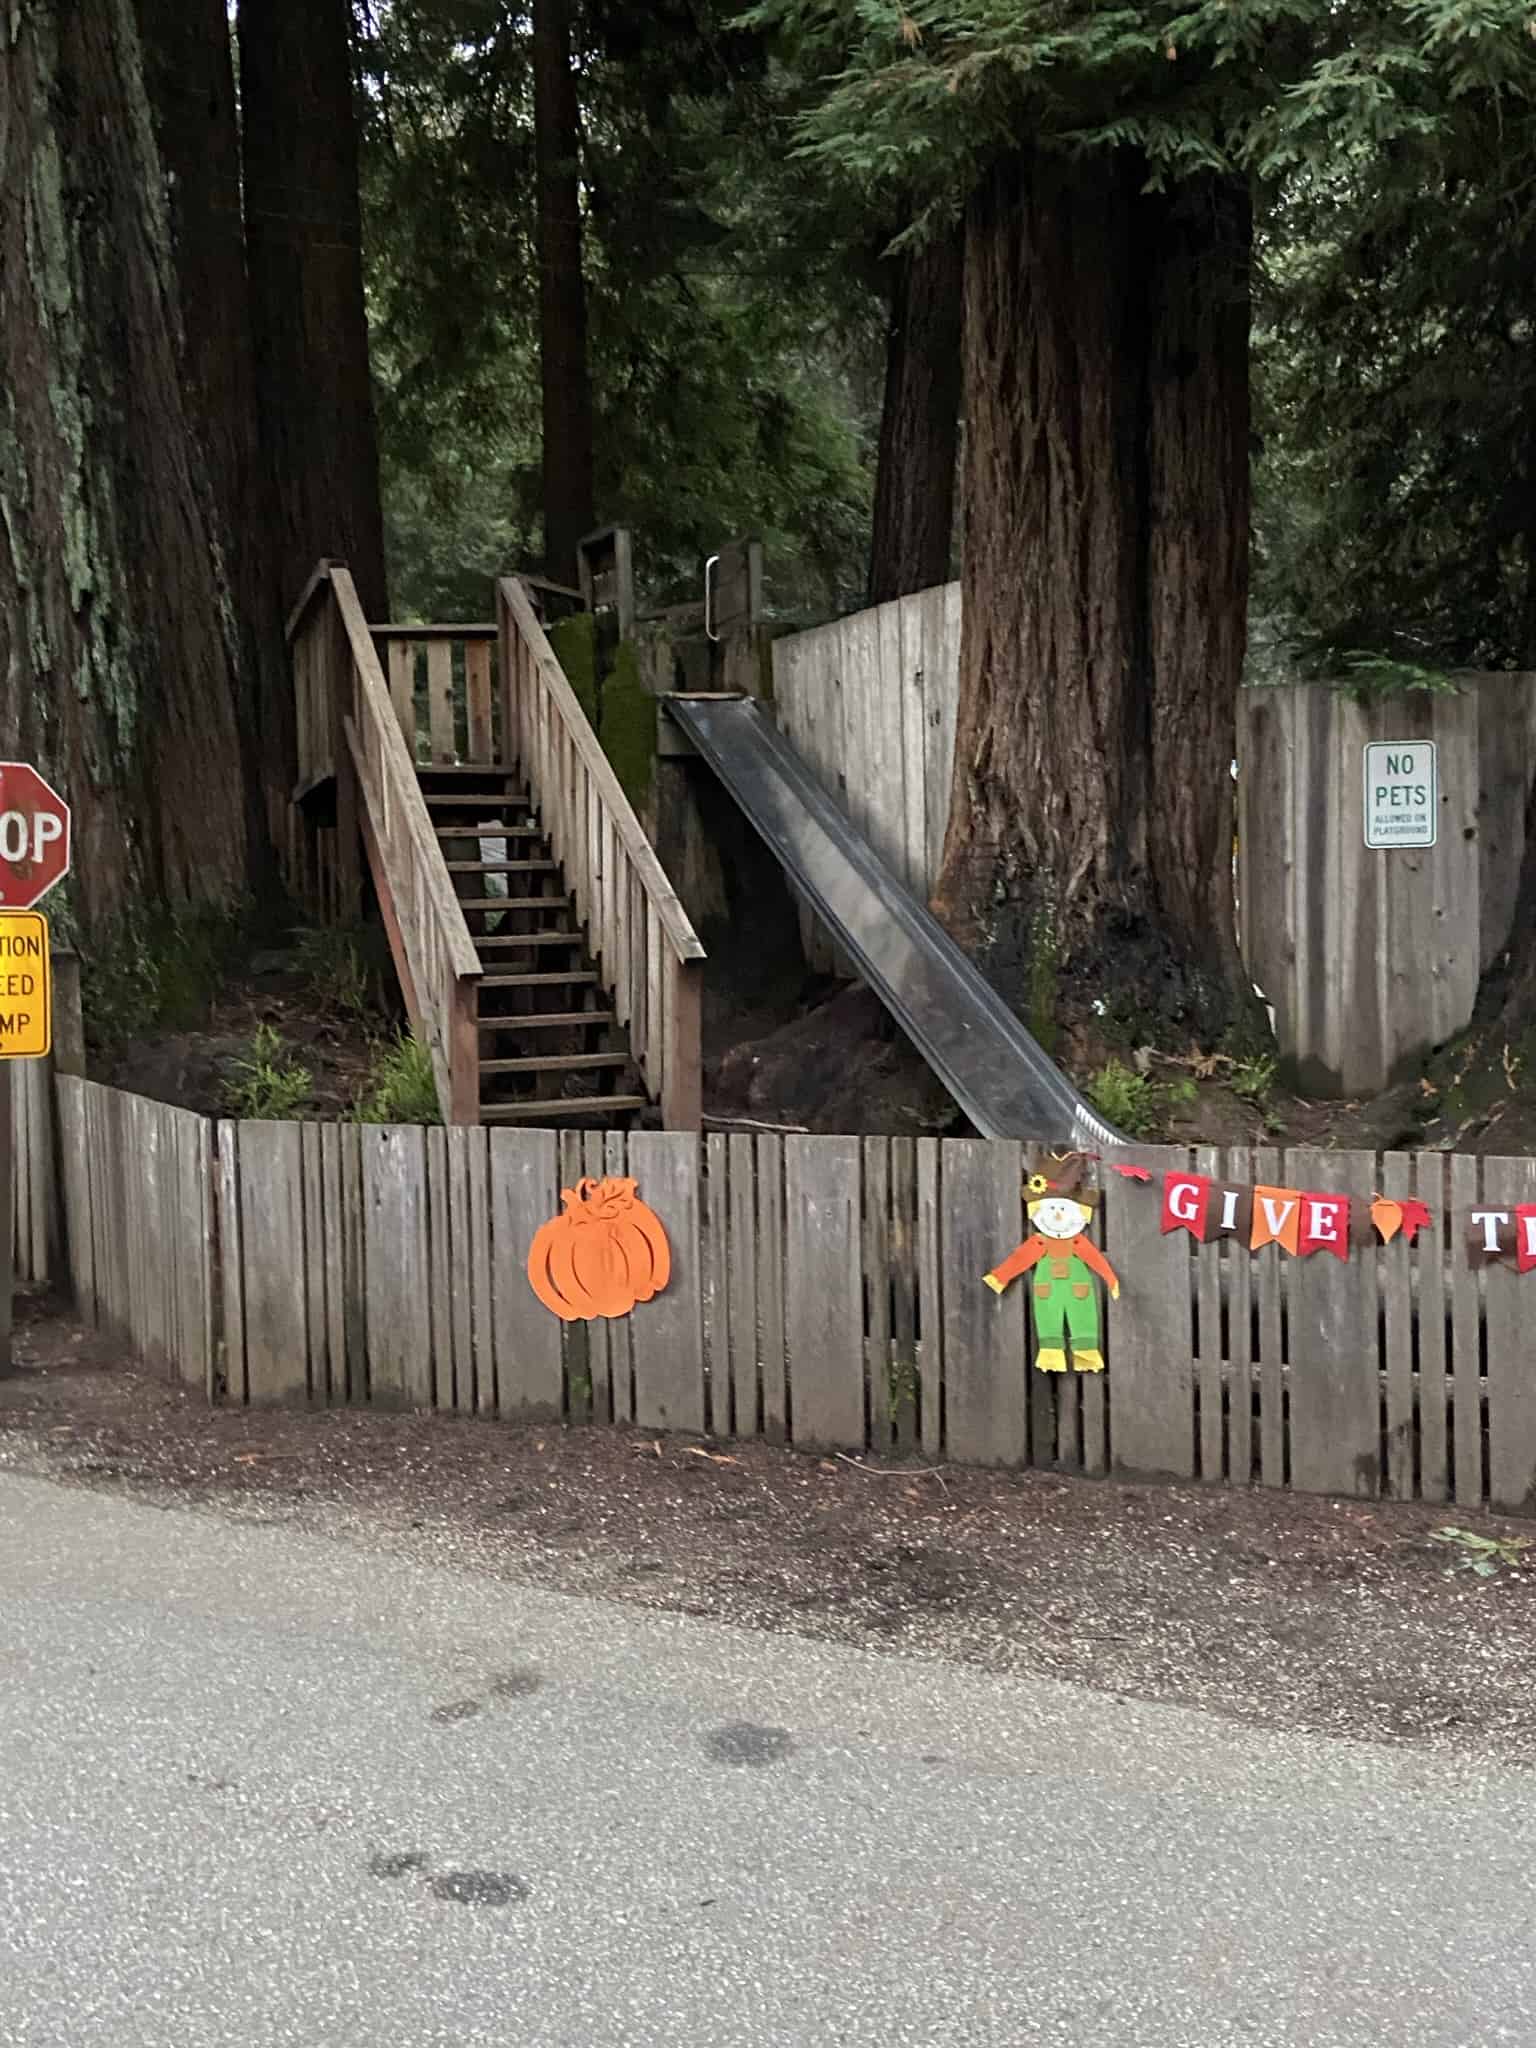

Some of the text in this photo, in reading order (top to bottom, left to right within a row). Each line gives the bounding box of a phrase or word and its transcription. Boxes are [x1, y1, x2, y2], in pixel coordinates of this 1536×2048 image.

[1386, 754, 1414, 775] NO
[1375, 785, 1427, 807] PETS
[1168, 1183, 1339, 1241] GIVE
